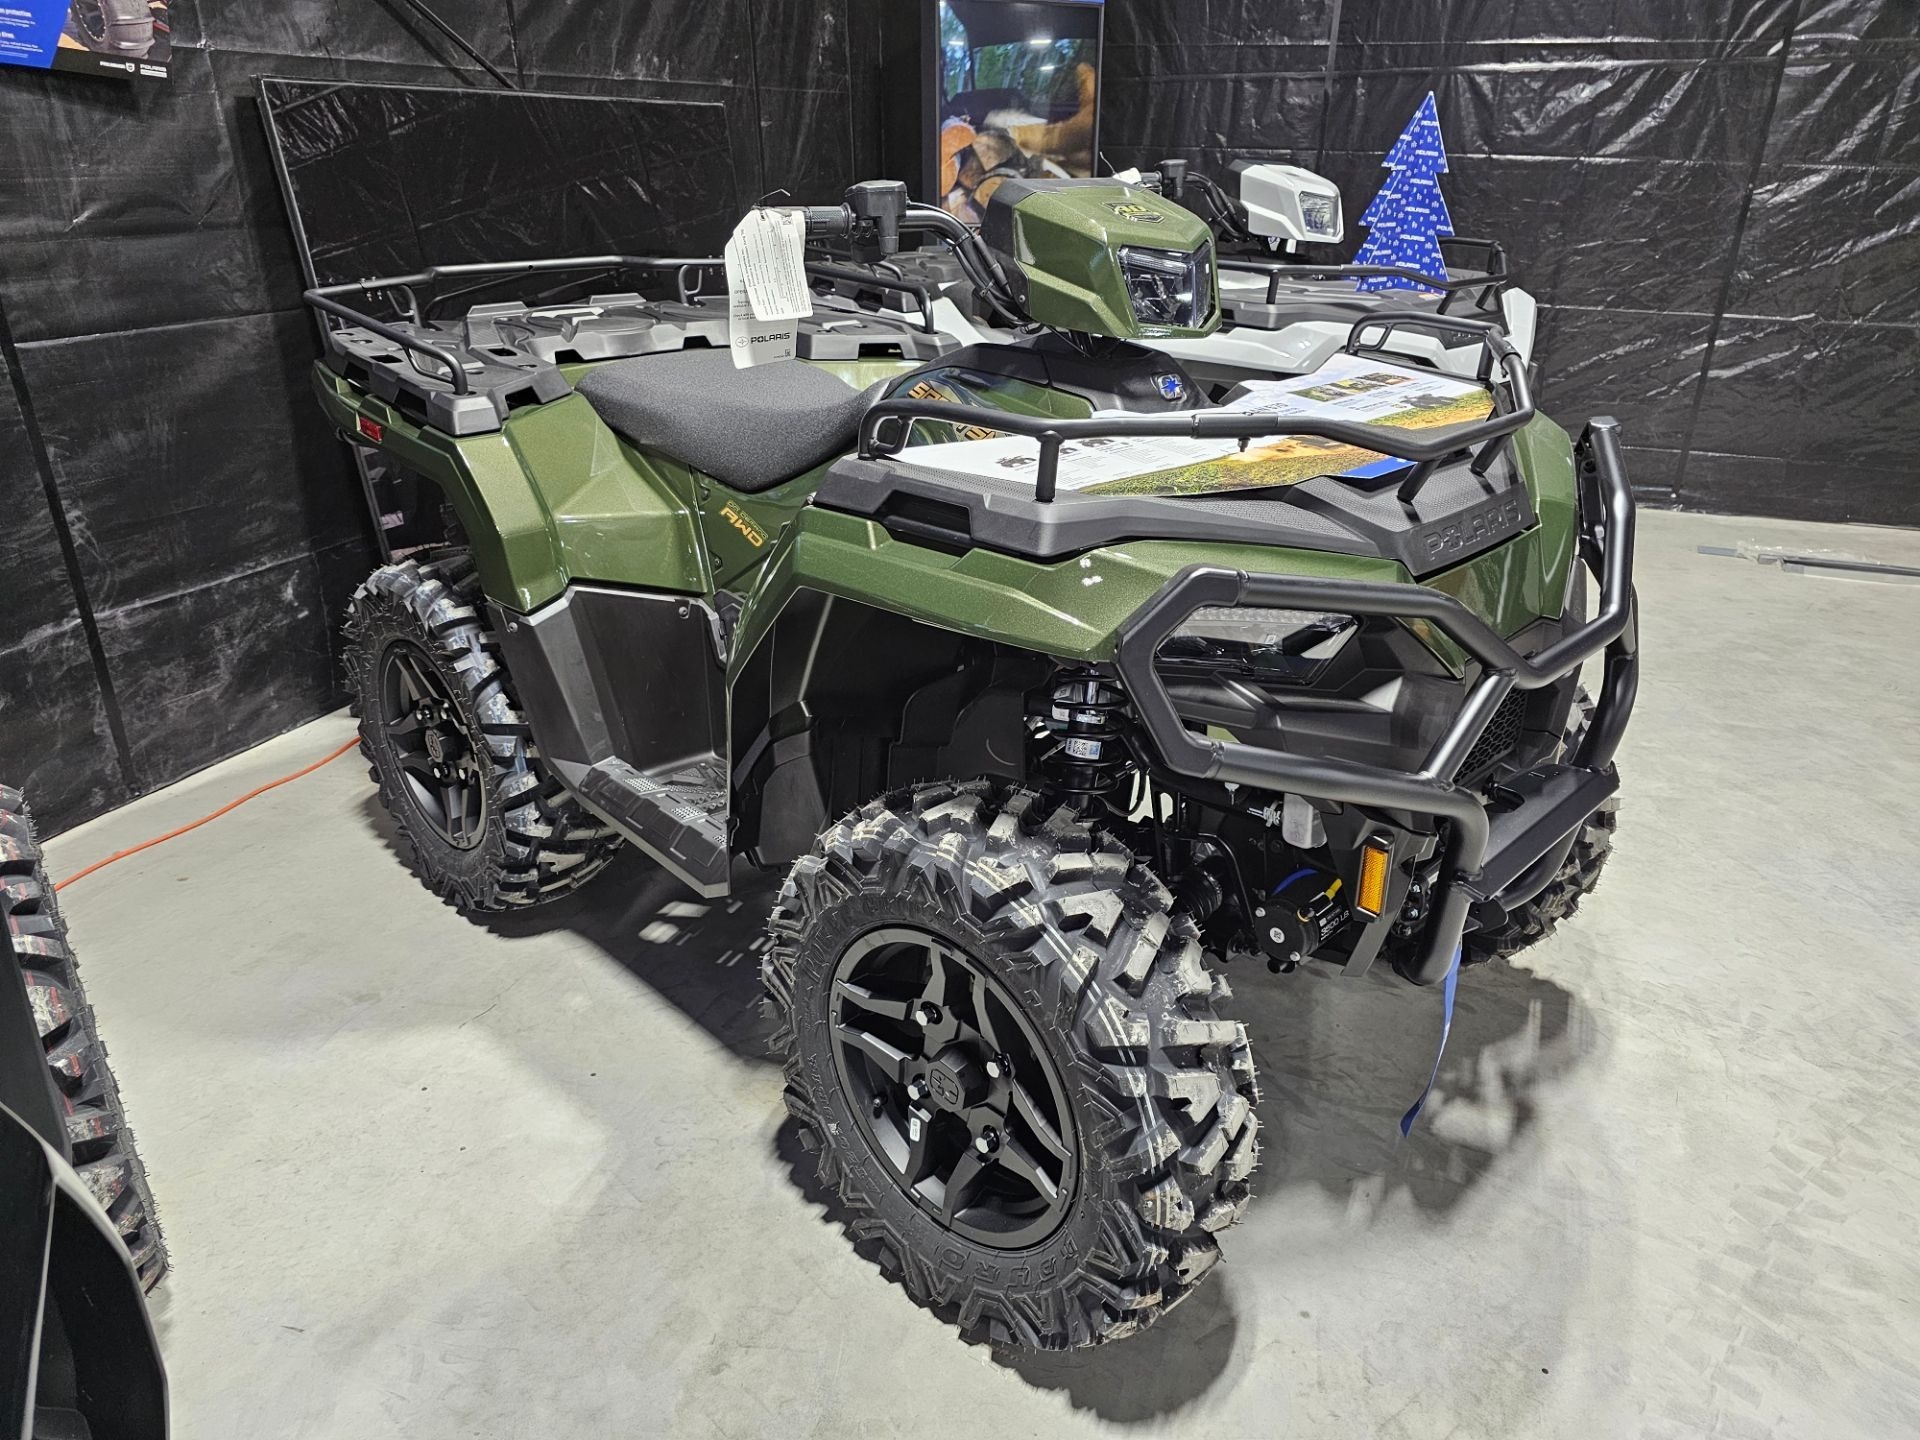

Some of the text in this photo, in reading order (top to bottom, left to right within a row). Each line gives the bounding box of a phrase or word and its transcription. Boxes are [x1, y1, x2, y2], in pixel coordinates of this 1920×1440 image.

[750, 332, 791, 345] POLARIS
[719, 506, 763, 547] AWD
[1424, 499, 1521, 561] POLARIS
